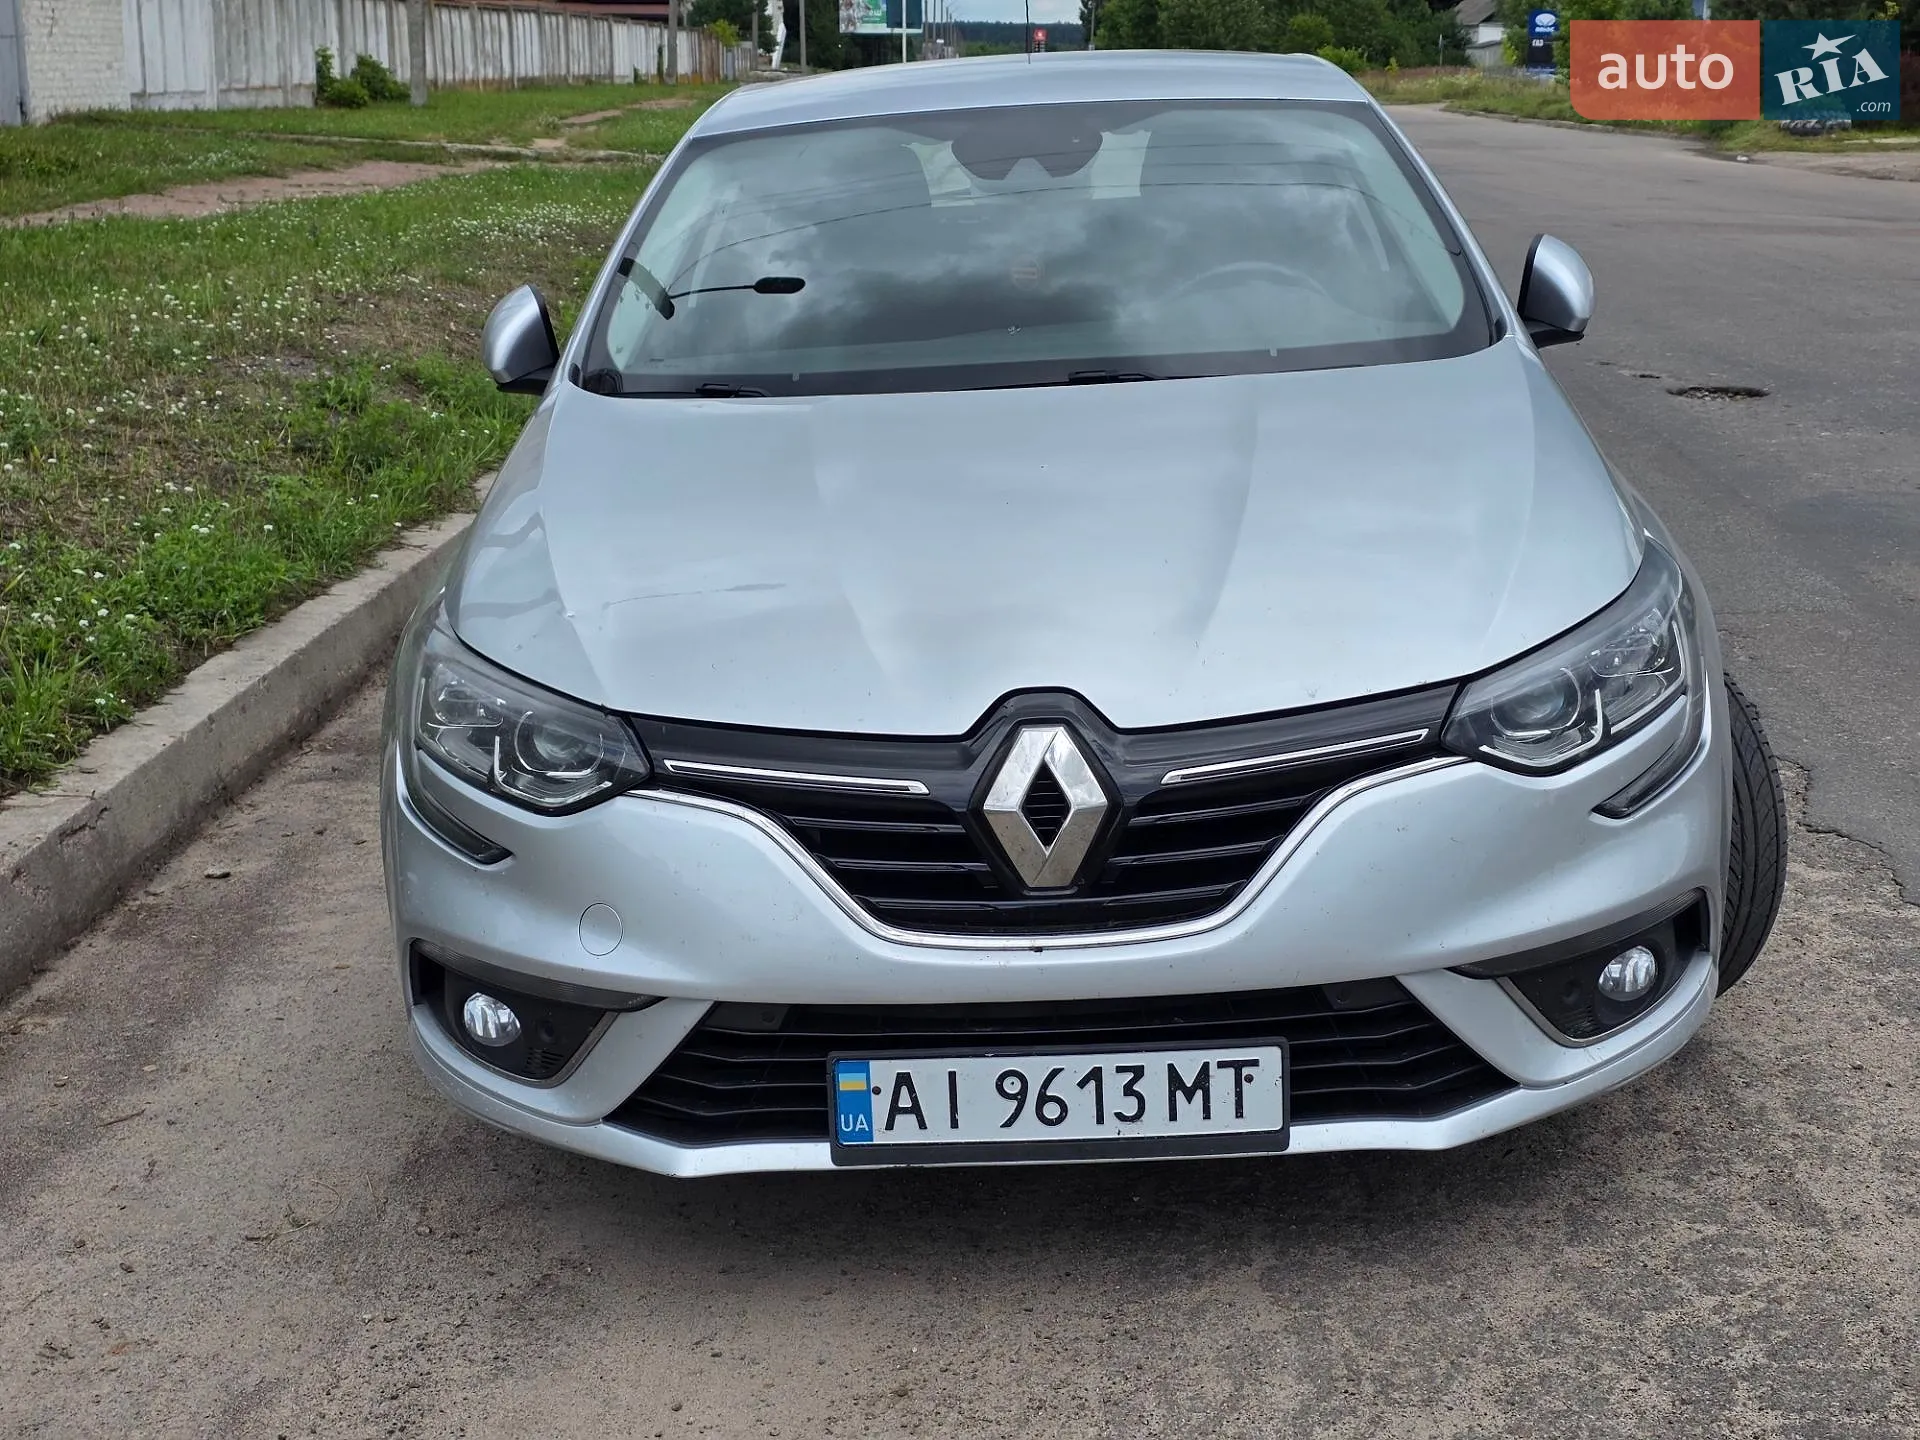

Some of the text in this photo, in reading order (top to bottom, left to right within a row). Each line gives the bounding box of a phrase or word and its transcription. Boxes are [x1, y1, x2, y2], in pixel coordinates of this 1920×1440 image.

[885, 1058, 1260, 1130] AI 9613 MT
[840, 1113, 869, 1132] UA
